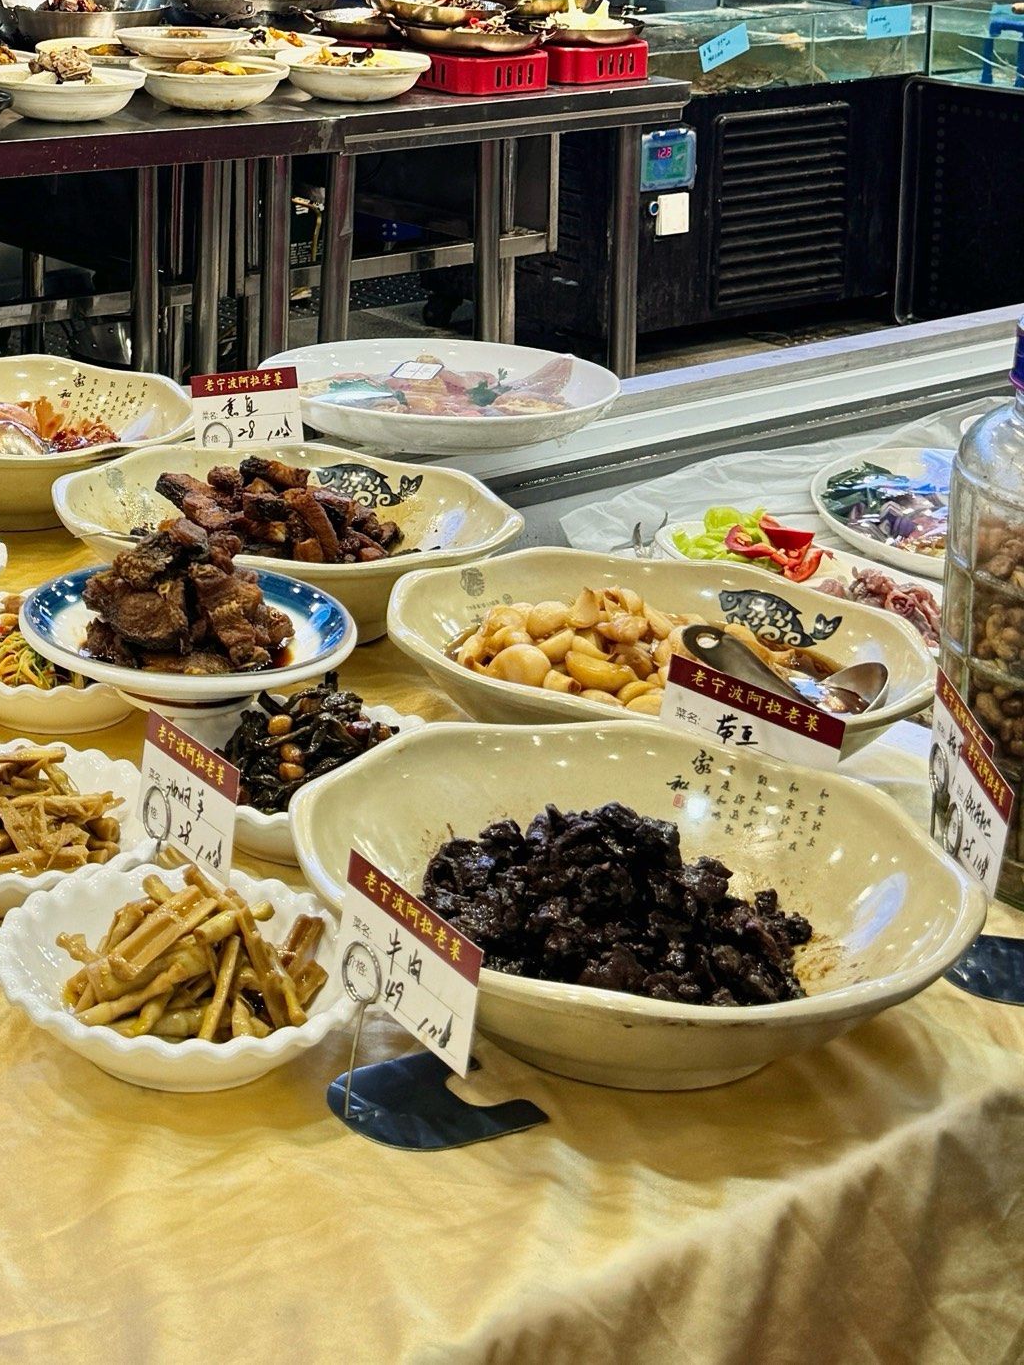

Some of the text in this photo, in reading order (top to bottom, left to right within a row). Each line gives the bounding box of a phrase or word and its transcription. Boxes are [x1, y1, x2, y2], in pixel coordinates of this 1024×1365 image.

[204, 371, 284, 392] 老宁波阿拉老菜
[237, 419, 255, 439] 28
[691, 669, 821, 733] 老宁波阿拉老菜
[157, 723, 226, 786] 老宁波阿拉老菜
[363, 870, 463, 962] 老宁波阿拉老菜
[385, 928, 423, 985] 牛肉
[384, 978, 405, 1012] 49
